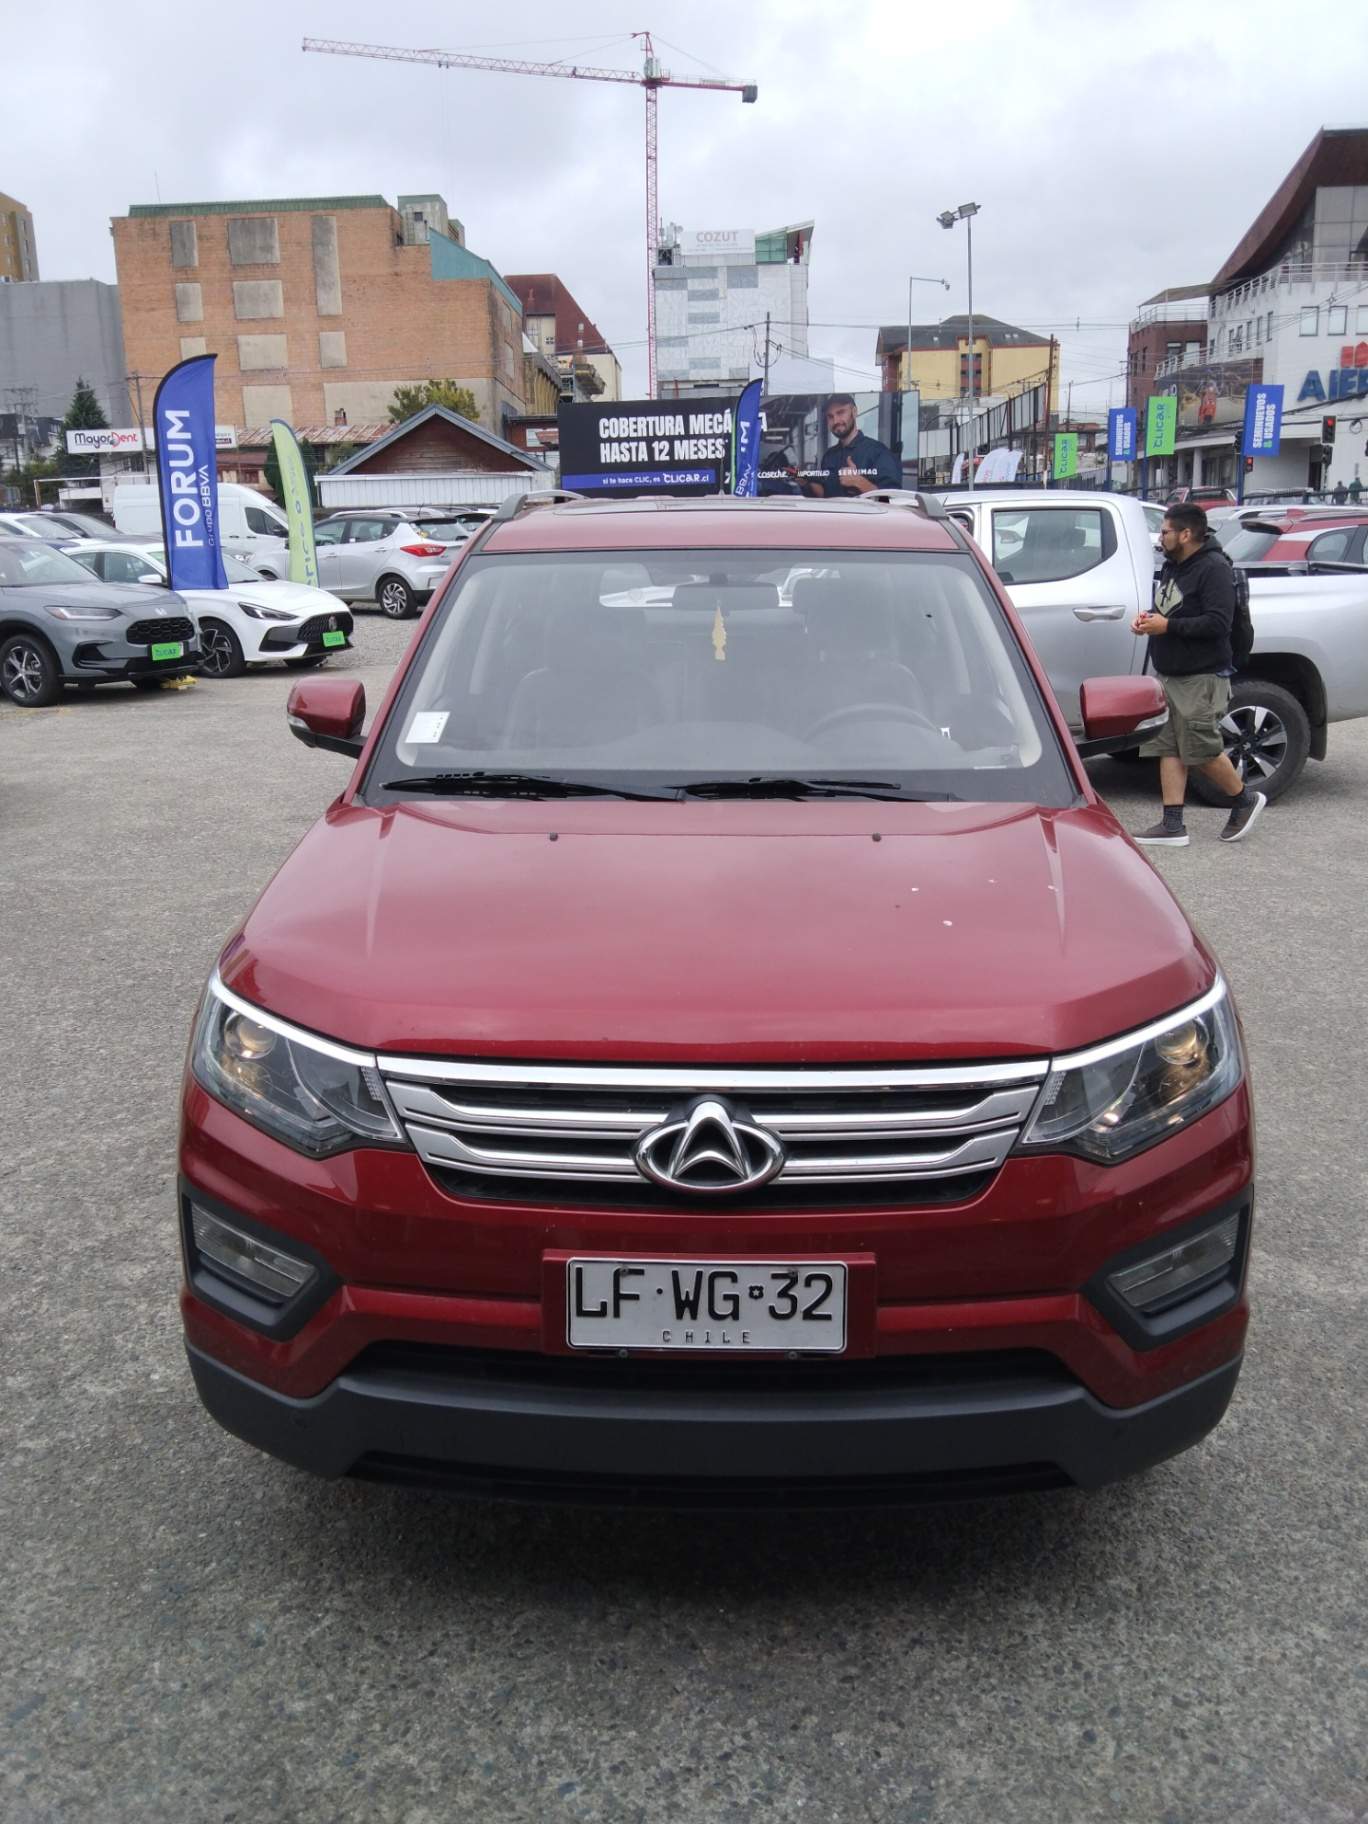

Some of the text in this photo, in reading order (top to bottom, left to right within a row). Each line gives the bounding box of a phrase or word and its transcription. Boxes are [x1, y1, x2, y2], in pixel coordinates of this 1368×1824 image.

[696, 231, 738, 242] COZUT
[599, 415, 685, 439] COBERTURA
[1252, 393, 1267, 449] SEMINUEVOS
[1263, 403, 1276, 439] USADOS
[600, 441, 649, 464] HASTA
[652, 440, 670, 461] 12
[165, 410, 204, 548] FORUM
[197, 464, 212, 507] BBVA
[662, 1330, 752, 1344] CHILE
